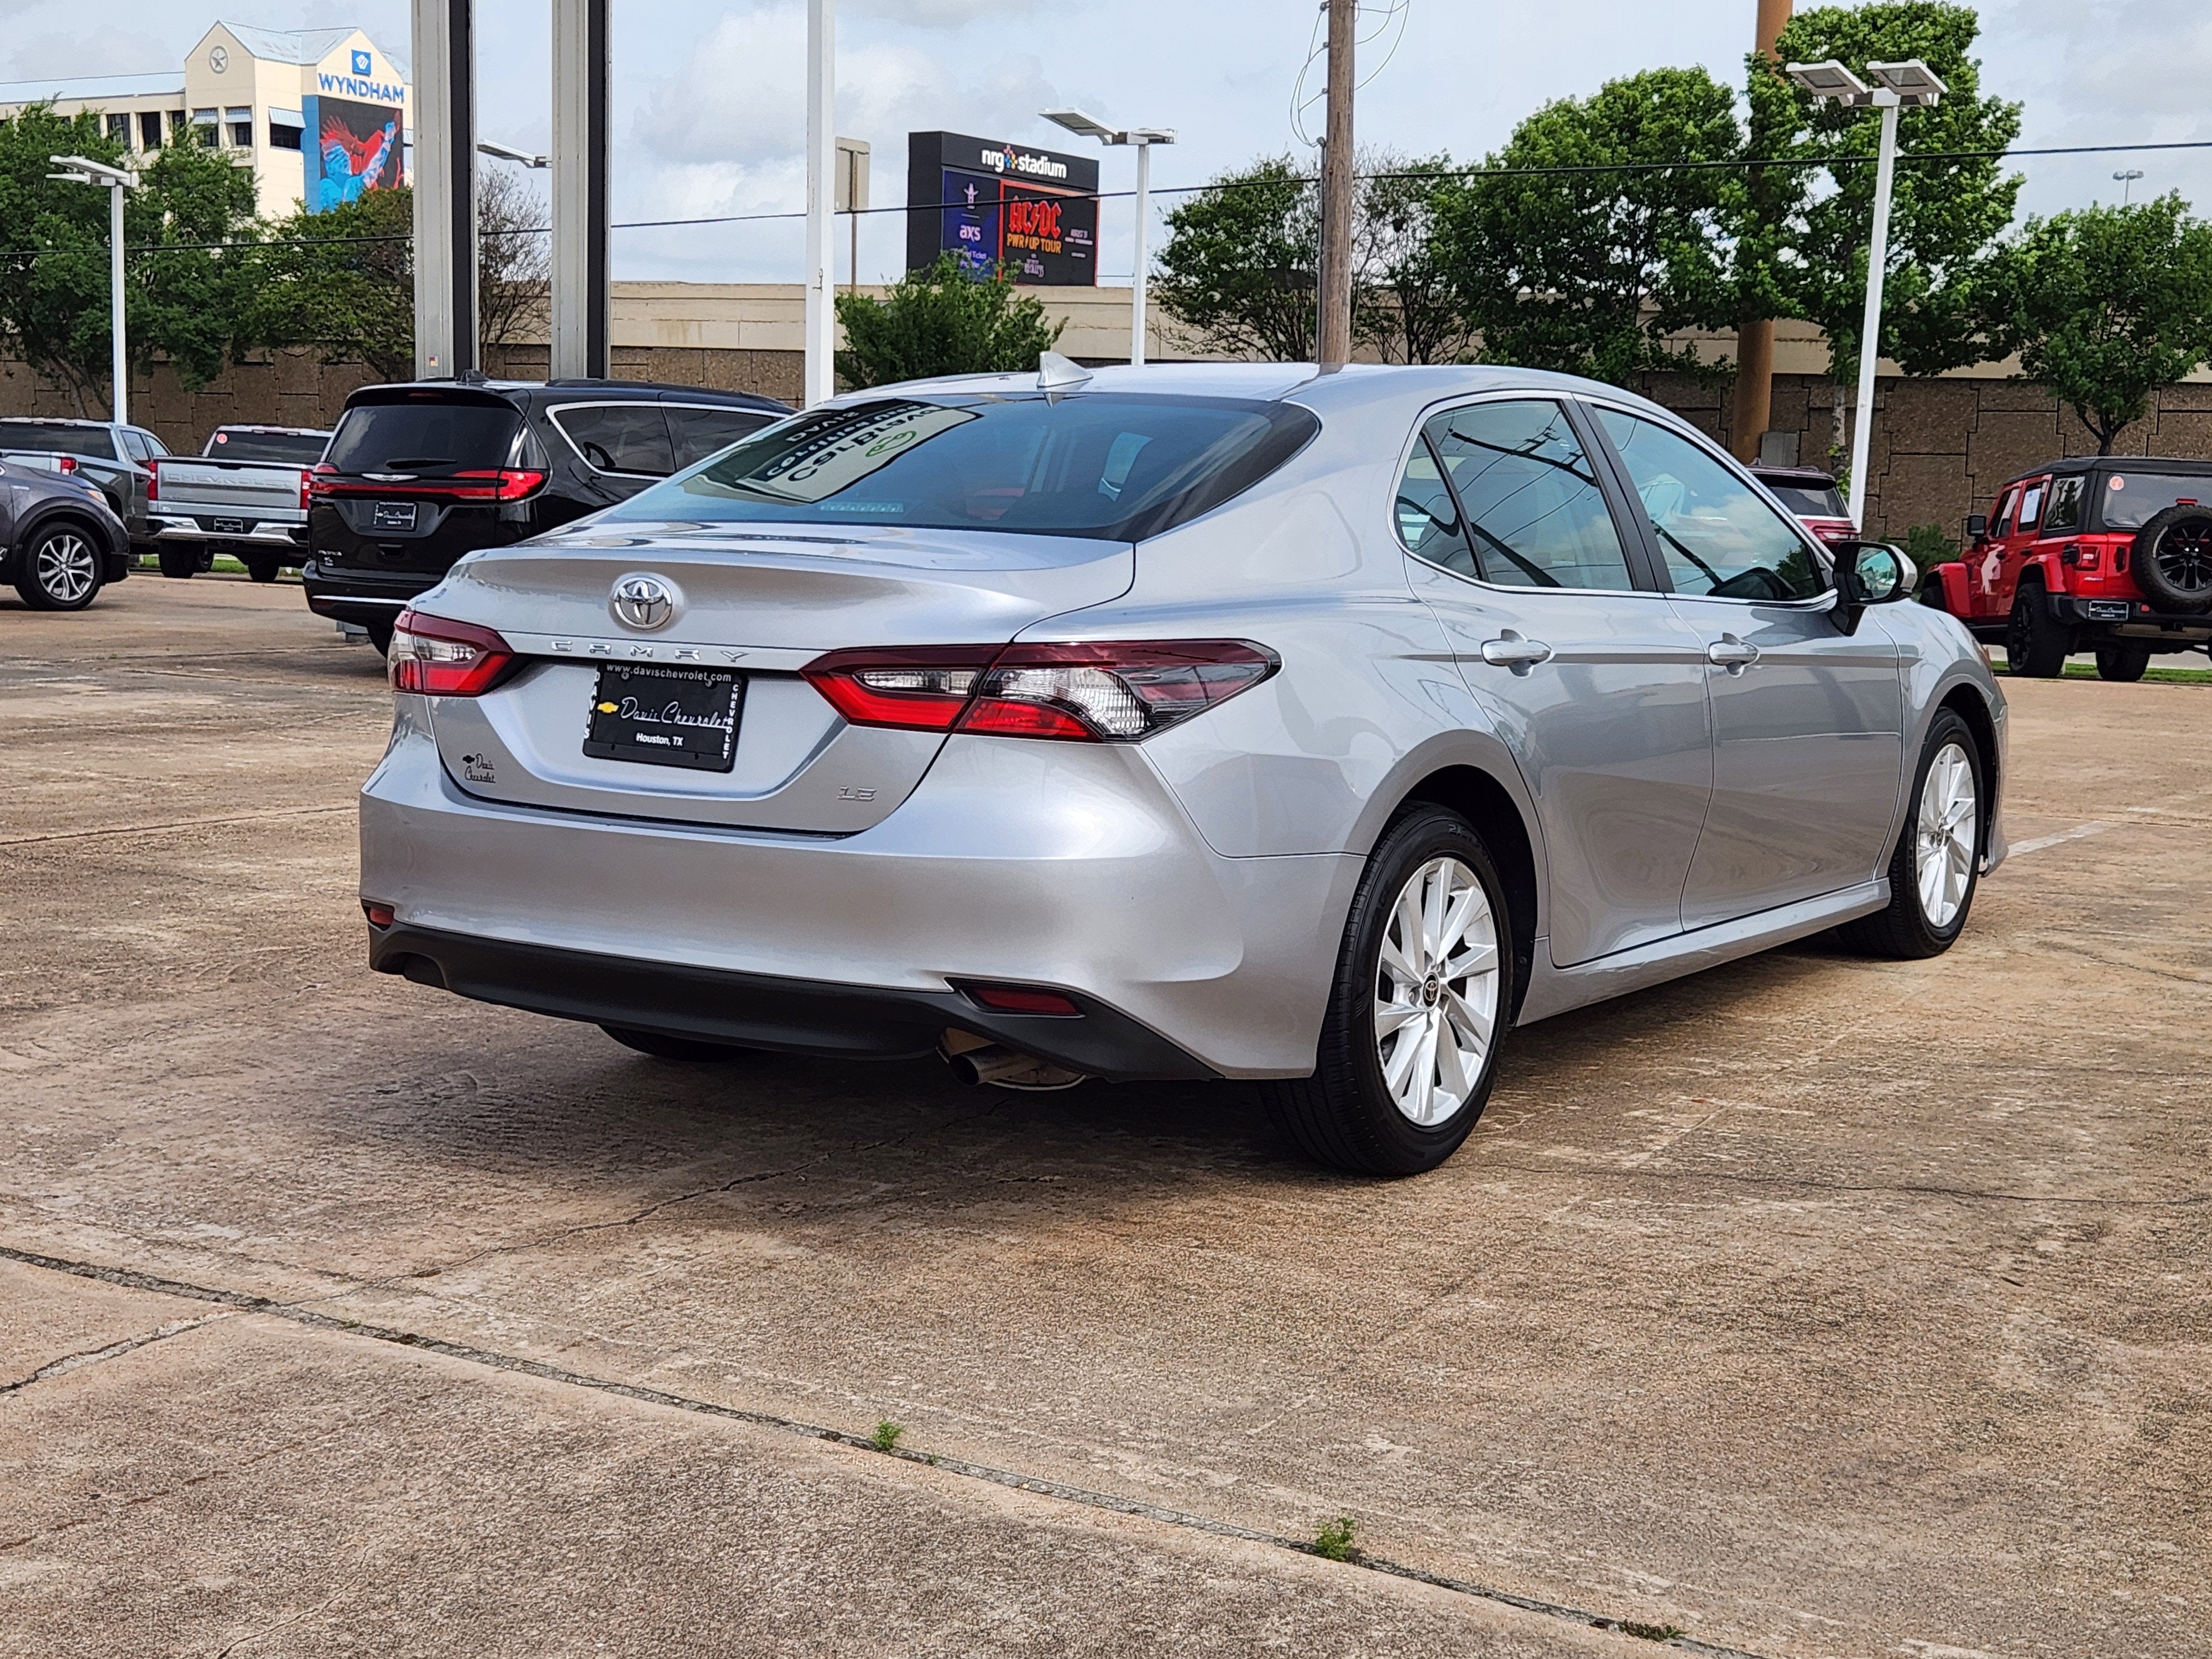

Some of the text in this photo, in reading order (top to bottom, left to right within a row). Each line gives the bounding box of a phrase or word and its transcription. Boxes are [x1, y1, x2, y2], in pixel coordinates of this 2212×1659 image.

[318, 73, 405, 103] WYNDHAM
[982, 149, 1067, 179] nrg stadium
[1009, 195, 1062, 239] AC/DC
[959, 223, 981, 242] axs
[1040, 238, 1062, 254] TOUR
[551, 640, 750, 663] CAMRY
[606, 664, 732, 682] www.davischevrolet.com
[620, 697, 729, 729] Davis Chevrolet
[636, 733, 684, 747] Houston, TX
[837, 786, 877, 802] LE
